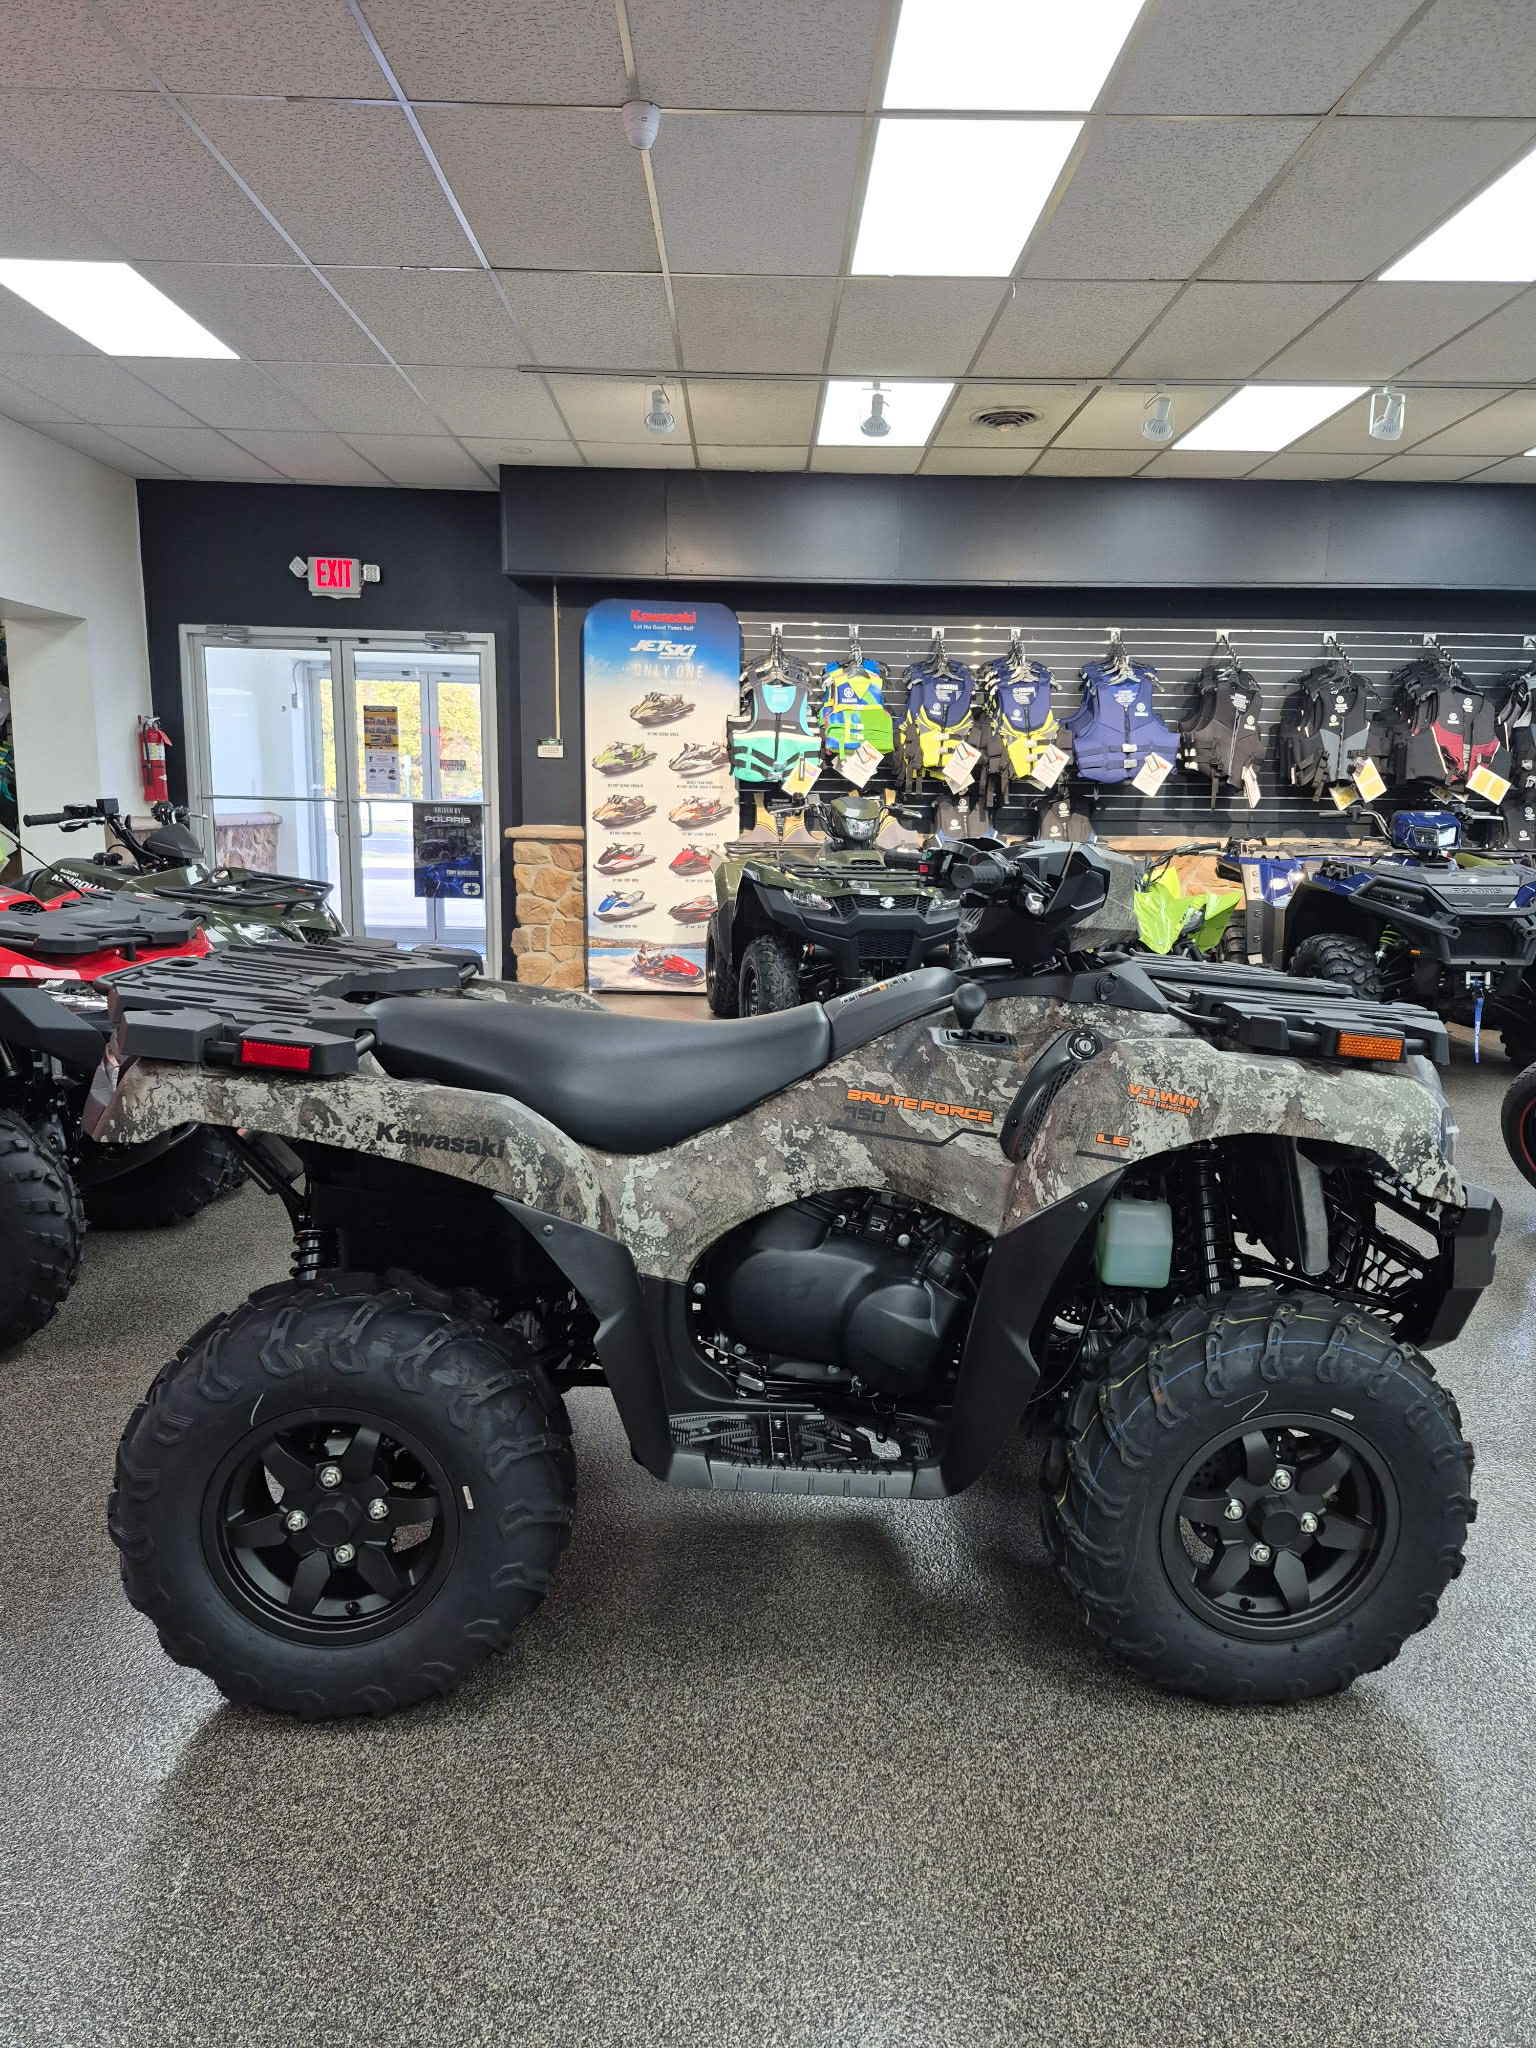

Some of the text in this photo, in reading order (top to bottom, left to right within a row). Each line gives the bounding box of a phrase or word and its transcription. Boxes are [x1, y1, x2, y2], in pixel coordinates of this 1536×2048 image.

[316, 559, 352, 588] EXIT
[423, 815, 472, 824] POLARIS
[847, 1089, 994, 1124] BRUTE FORCE
[1127, 1082, 1200, 1109] V-TWIN
[375, 1121, 506, 1159] Kawasaki
[1096, 1132, 1131, 1147] LE
